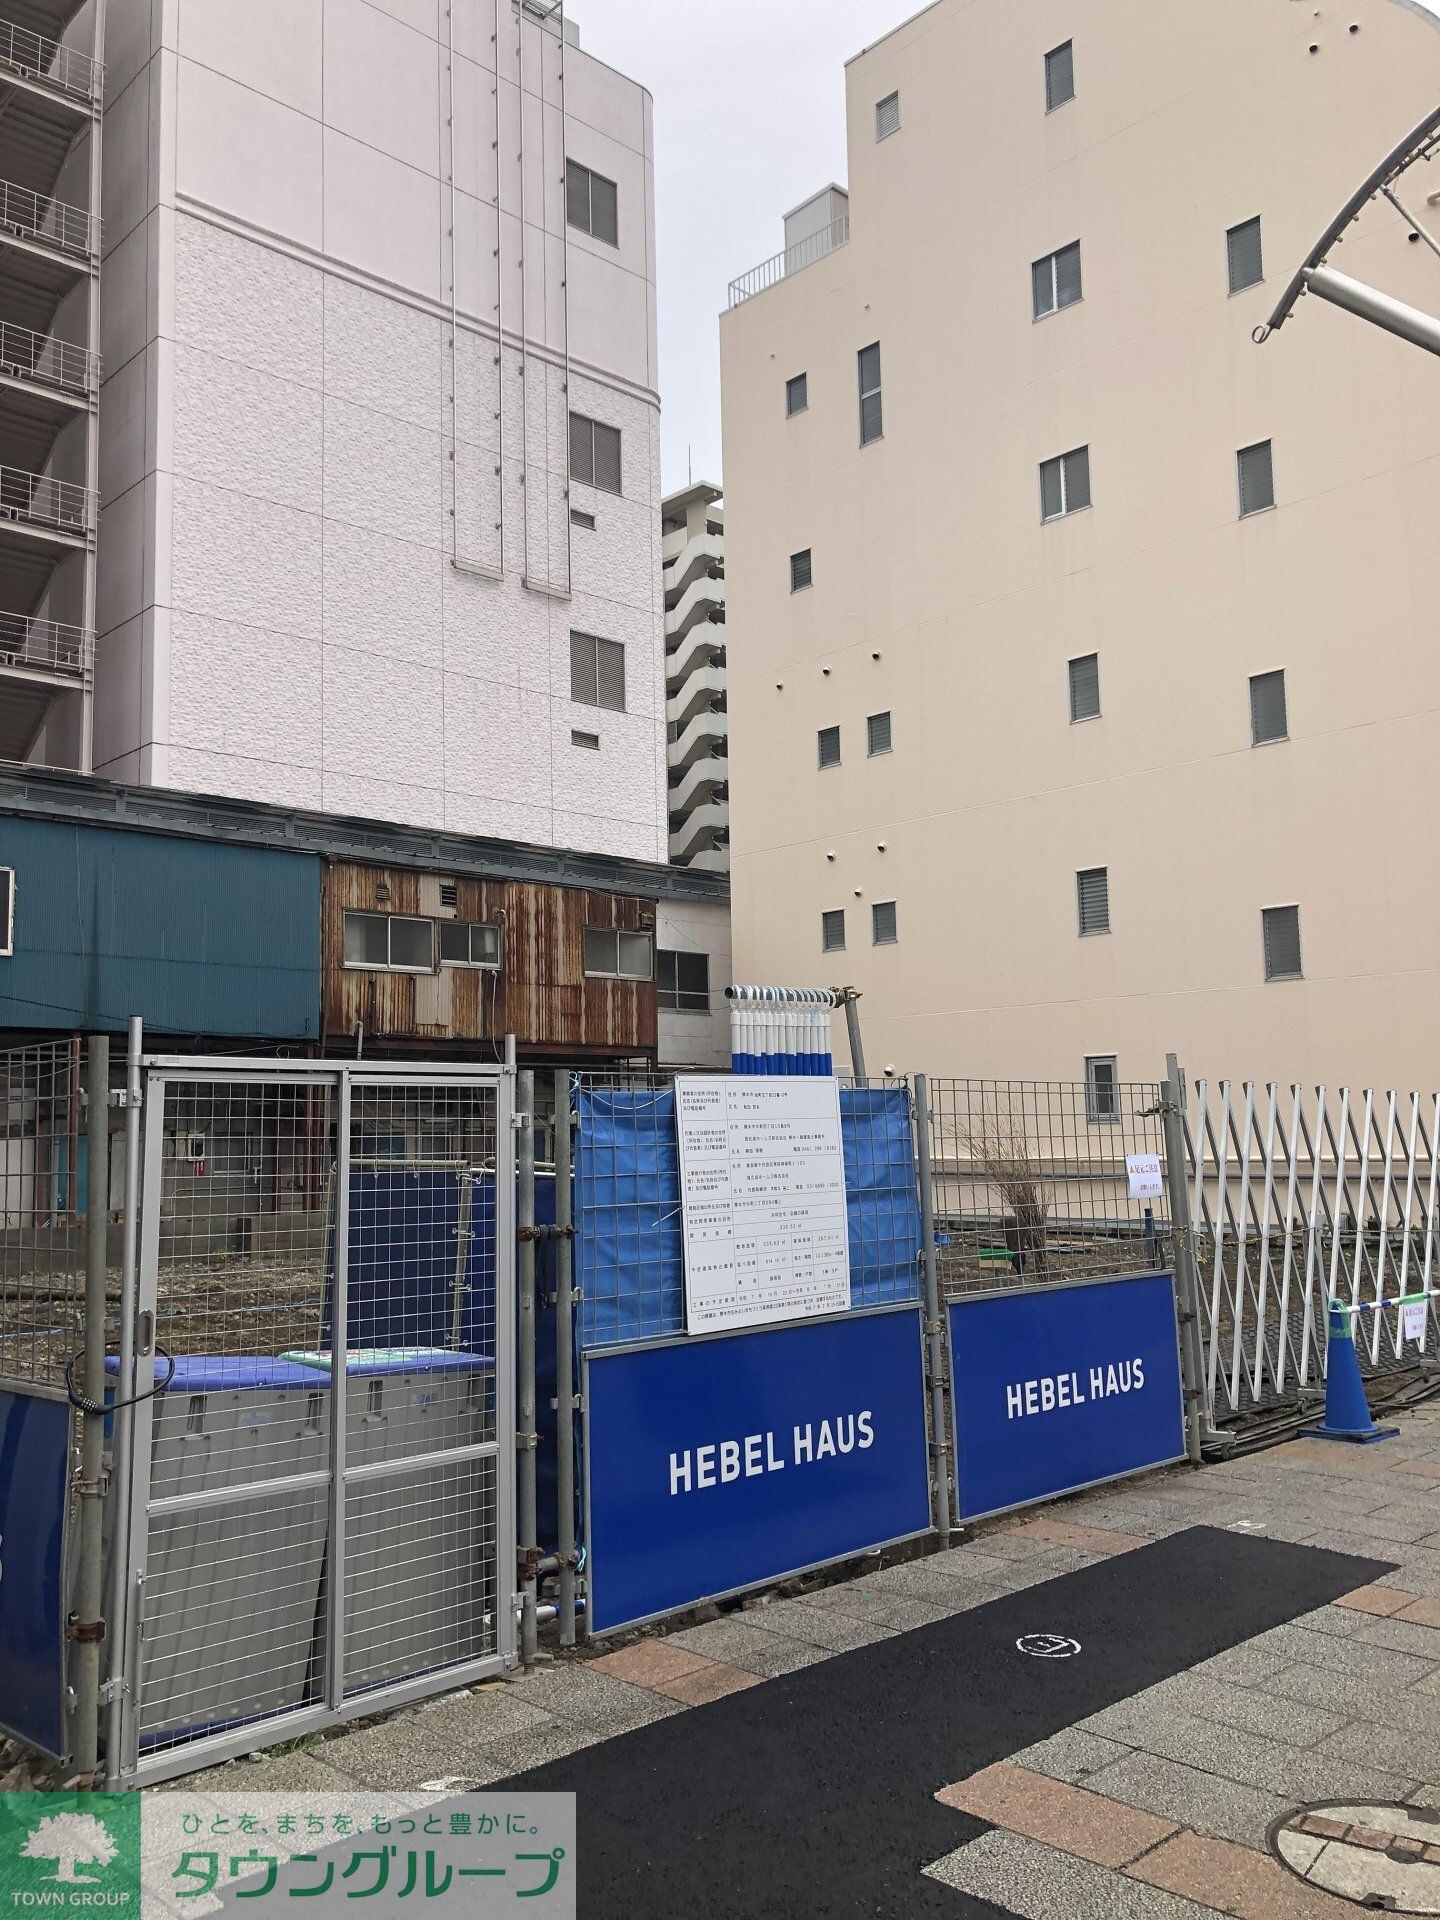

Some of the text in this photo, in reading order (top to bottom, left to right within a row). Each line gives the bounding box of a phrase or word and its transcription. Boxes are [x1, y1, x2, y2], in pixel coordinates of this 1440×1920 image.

[1007, 1358, 1145, 1419] HEBEL HAUS
[670, 1411, 874, 1495] HEBEL HAUS
